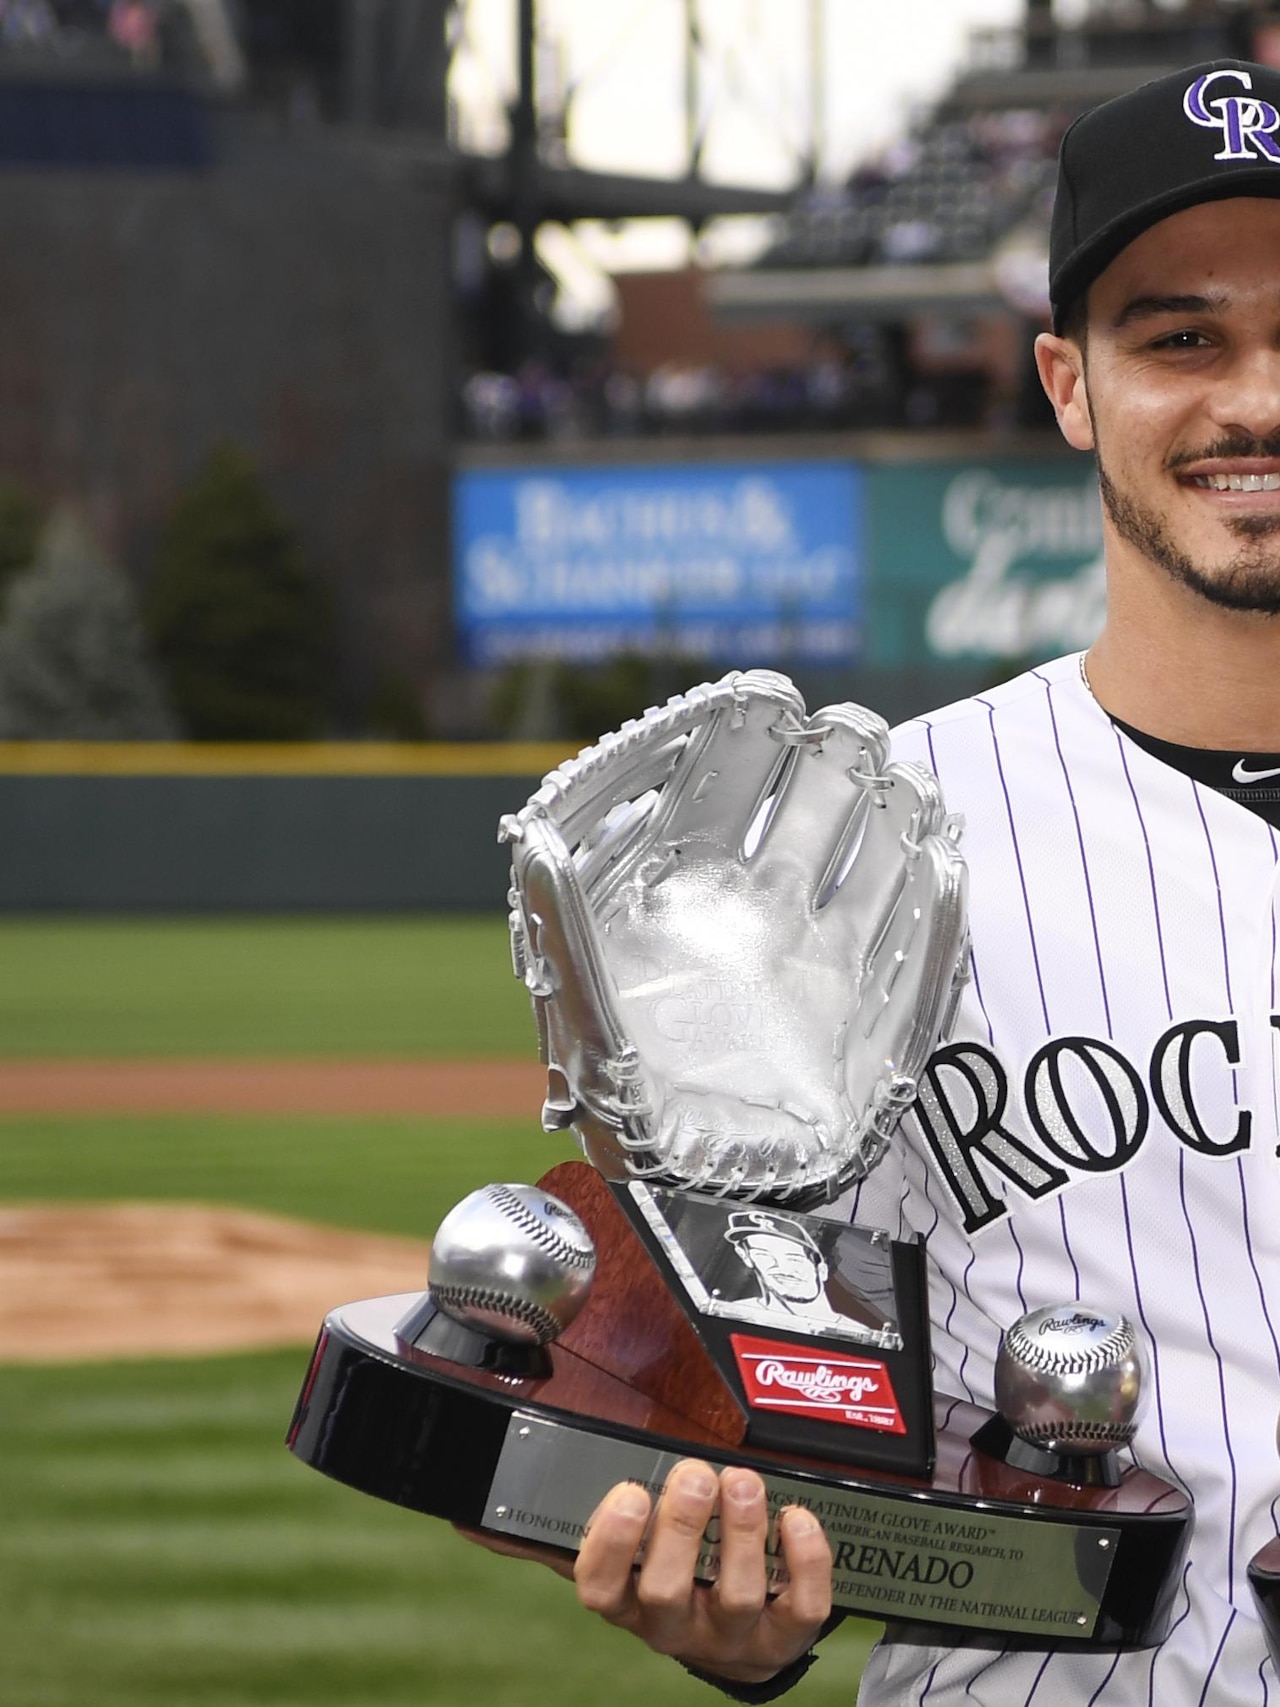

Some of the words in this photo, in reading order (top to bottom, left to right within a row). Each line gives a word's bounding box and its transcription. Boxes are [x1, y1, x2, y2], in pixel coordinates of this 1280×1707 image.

[1038, 1313, 1106, 1335] Rawlings
[755, 1360, 879, 1401] Rawlings
[507, 1508, 591, 1538] HONORIN
[881, 1512, 931, 1533] GLOVE
[828, 1521, 891, 1540] AMERICAN
[893, 1530, 947, 1550] BASEBALL
[1008, 1549, 1024, 1560] TO
[833, 1541, 974, 1589] RENADO
[909, 1593, 926, 1606] IN
[929, 1595, 959, 1611] THE
[960, 1600, 1028, 1620] NATIONAL
